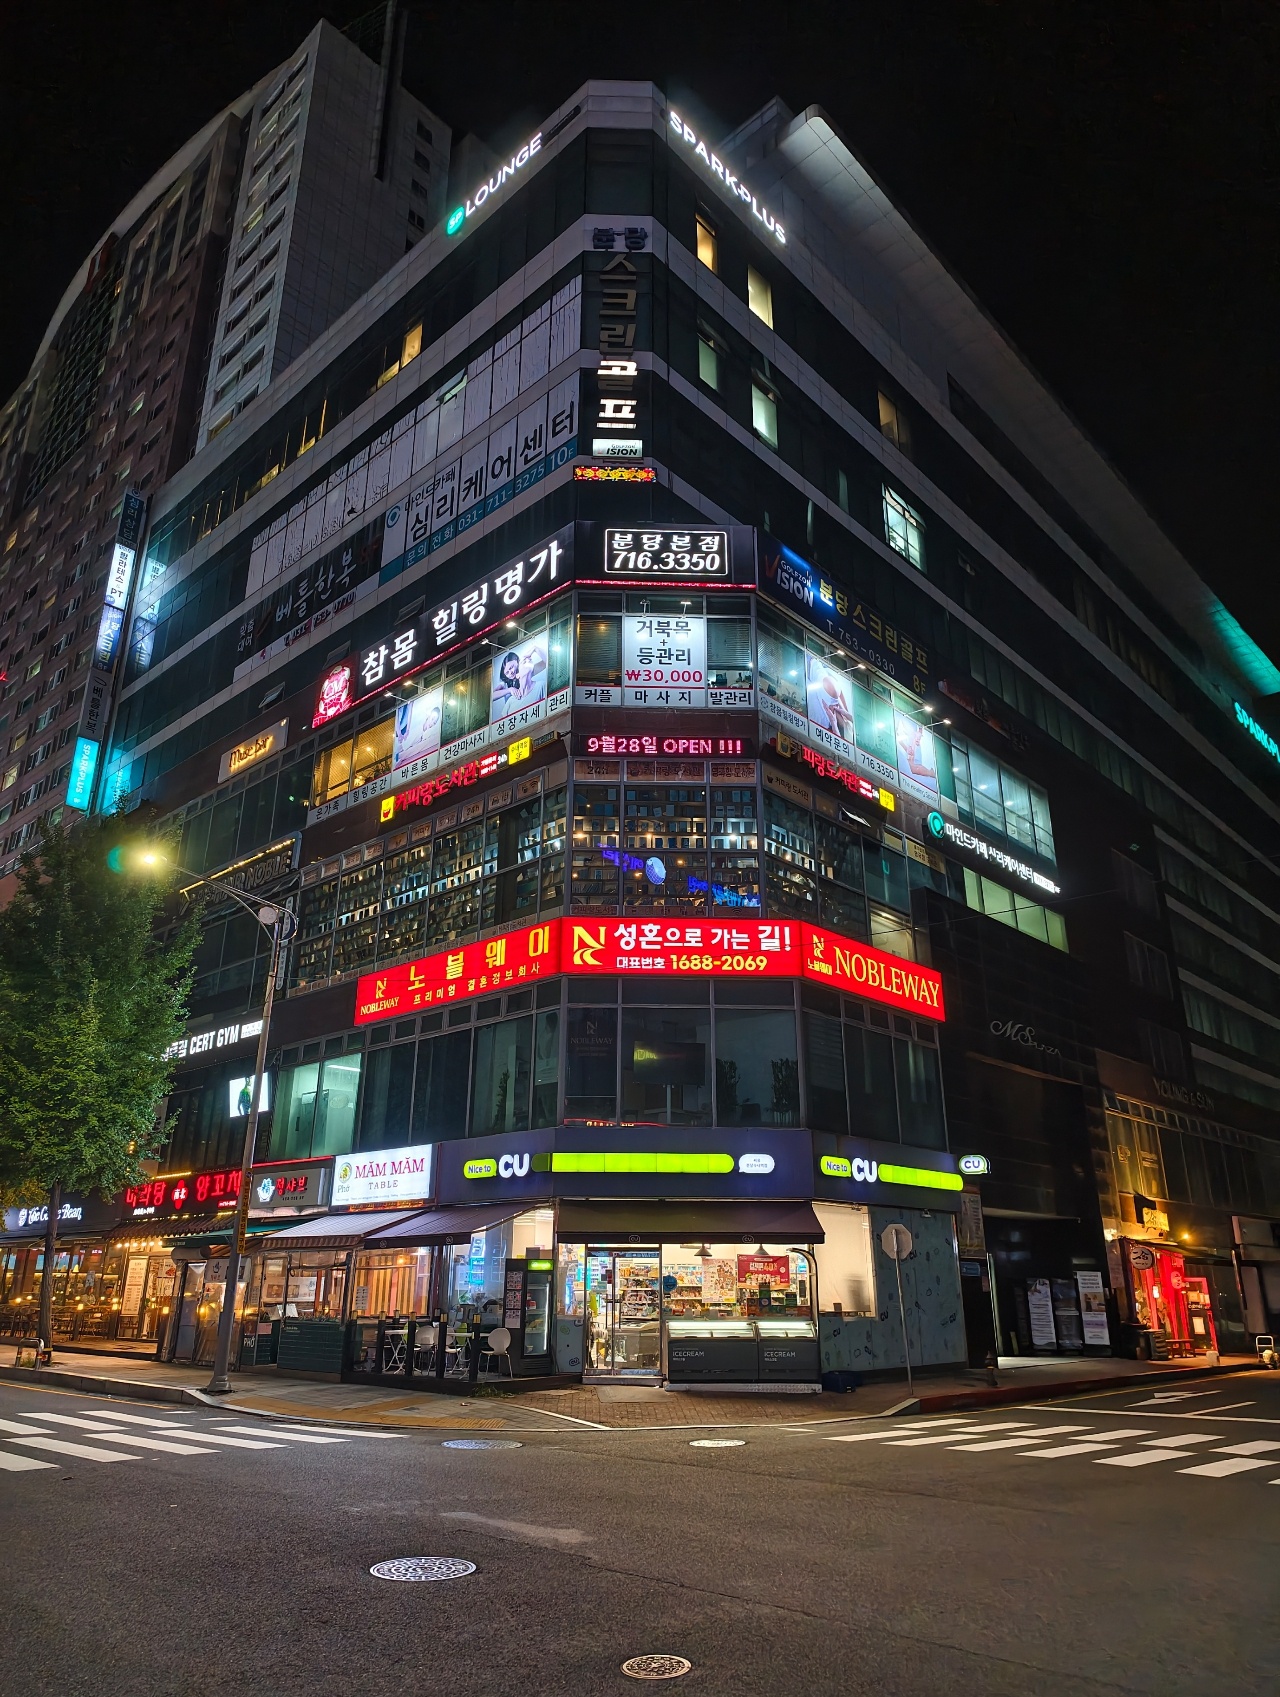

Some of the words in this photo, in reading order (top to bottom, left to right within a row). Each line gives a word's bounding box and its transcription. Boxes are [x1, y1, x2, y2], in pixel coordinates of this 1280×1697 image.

[465, 132, 543, 214] LOUNGE
[670, 110, 787, 244] SPARKPLUS
[550, 447, 575, 471] 10F
[411, 400, 575, 543] 심리케어센터
[404, 466, 456, 514] 마인드카페
[612, 533, 720, 552] 분당본점
[115, 551, 129, 584] 필라테스
[613, 551, 720, 571] 716.3350
[110, 587, 124, 598] PT
[432, 540, 563, 646] 힐링명가
[637, 620, 691, 638] 거북목
[820, 579, 848, 617] 분당
[853, 604, 928, 675] 스크린골프
[637, 647, 691, 665] 등관리
[839, 628, 895, 675] 753-0330
[625, 669, 703, 684] ₩30,000
[913, 674, 926, 694] 8F
[549, 692, 568, 712] 관리
[585, 689, 612, 703] 커플
[635, 690, 692, 704] 마사지
[710, 692, 751, 705] 발관리
[497, 706, 541, 736] 성장자세
[444, 733, 485, 760] 건강마사지
[588, 736, 657, 753] 9월28일
[663, 739, 712, 754] OPEN
[719, 740, 741, 754] !!!
[816, 727, 850, 757] 예약문의
[75, 744, 91, 794] SPARKPLUS
[401, 759, 429, 779] 바른몸
[861, 754, 894, 780] 716.3350
[352, 777, 388, 803] 힐링공간
[394, 759, 480, 809] 커피랑도서관
[316, 800, 340, 820] 온가족
[946, 823, 988, 859] 마인드카페
[613, 924, 702, 952] 성혼으로
[711, 926, 751, 950] 가는
[758, 925, 791, 952] 길!
[408, 925, 551, 991] 노블웨이
[616, 956, 666, 970] 대표번호
[670, 954, 768, 971] 1688-2069
[807, 961, 833, 977] 노블웨이
[413, 984, 456, 1005] 프리미엄
[467, 961, 541, 992] 결혼정보회사
[834, 946, 940, 1008] NOBLEWAY
[360, 996, 400, 1016] NOBLEWAY
[190, 1030, 216, 1055] CERT
[216, 1024, 239, 1047] GYM
[468, 1164, 483, 1174] Nice
[483, 1164, 491, 1174] to
[499, 1153, 529, 1178] CU
[826, 1161, 840, 1172] Nice
[841, 1164, 848, 1172] to
[852, 1157, 878, 1183] CU
[964, 1160, 981, 1169] CU
[276, 1177, 306, 1195] 정샤브
[368, 1180, 399, 1190] TABLE
[62, 1203, 82, 1221] Bean
[672, 1350, 705, 1358] ICECREAM
